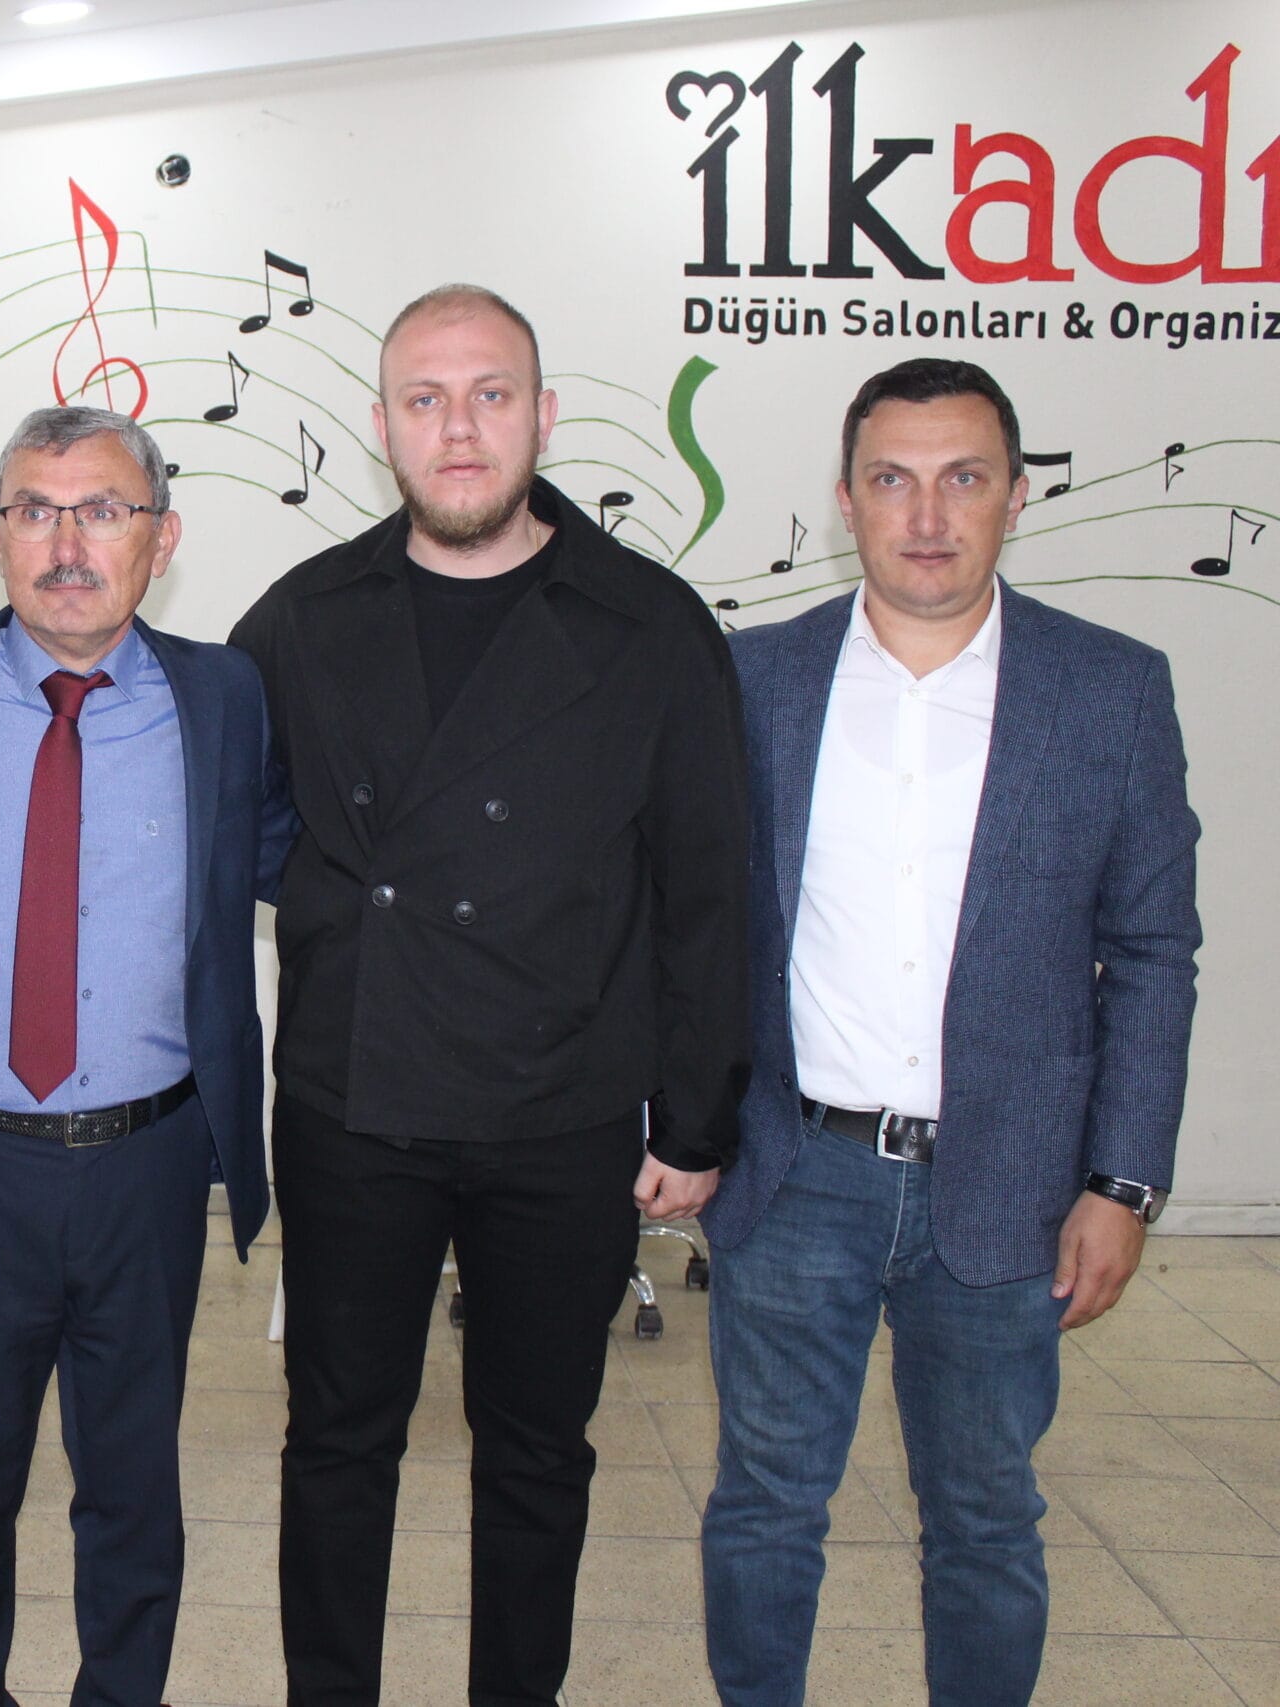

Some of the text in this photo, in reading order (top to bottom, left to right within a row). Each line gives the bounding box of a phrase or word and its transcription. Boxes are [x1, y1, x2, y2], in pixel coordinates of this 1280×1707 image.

[684, 296, 1280, 350] Düğün Salonları & Organiz
